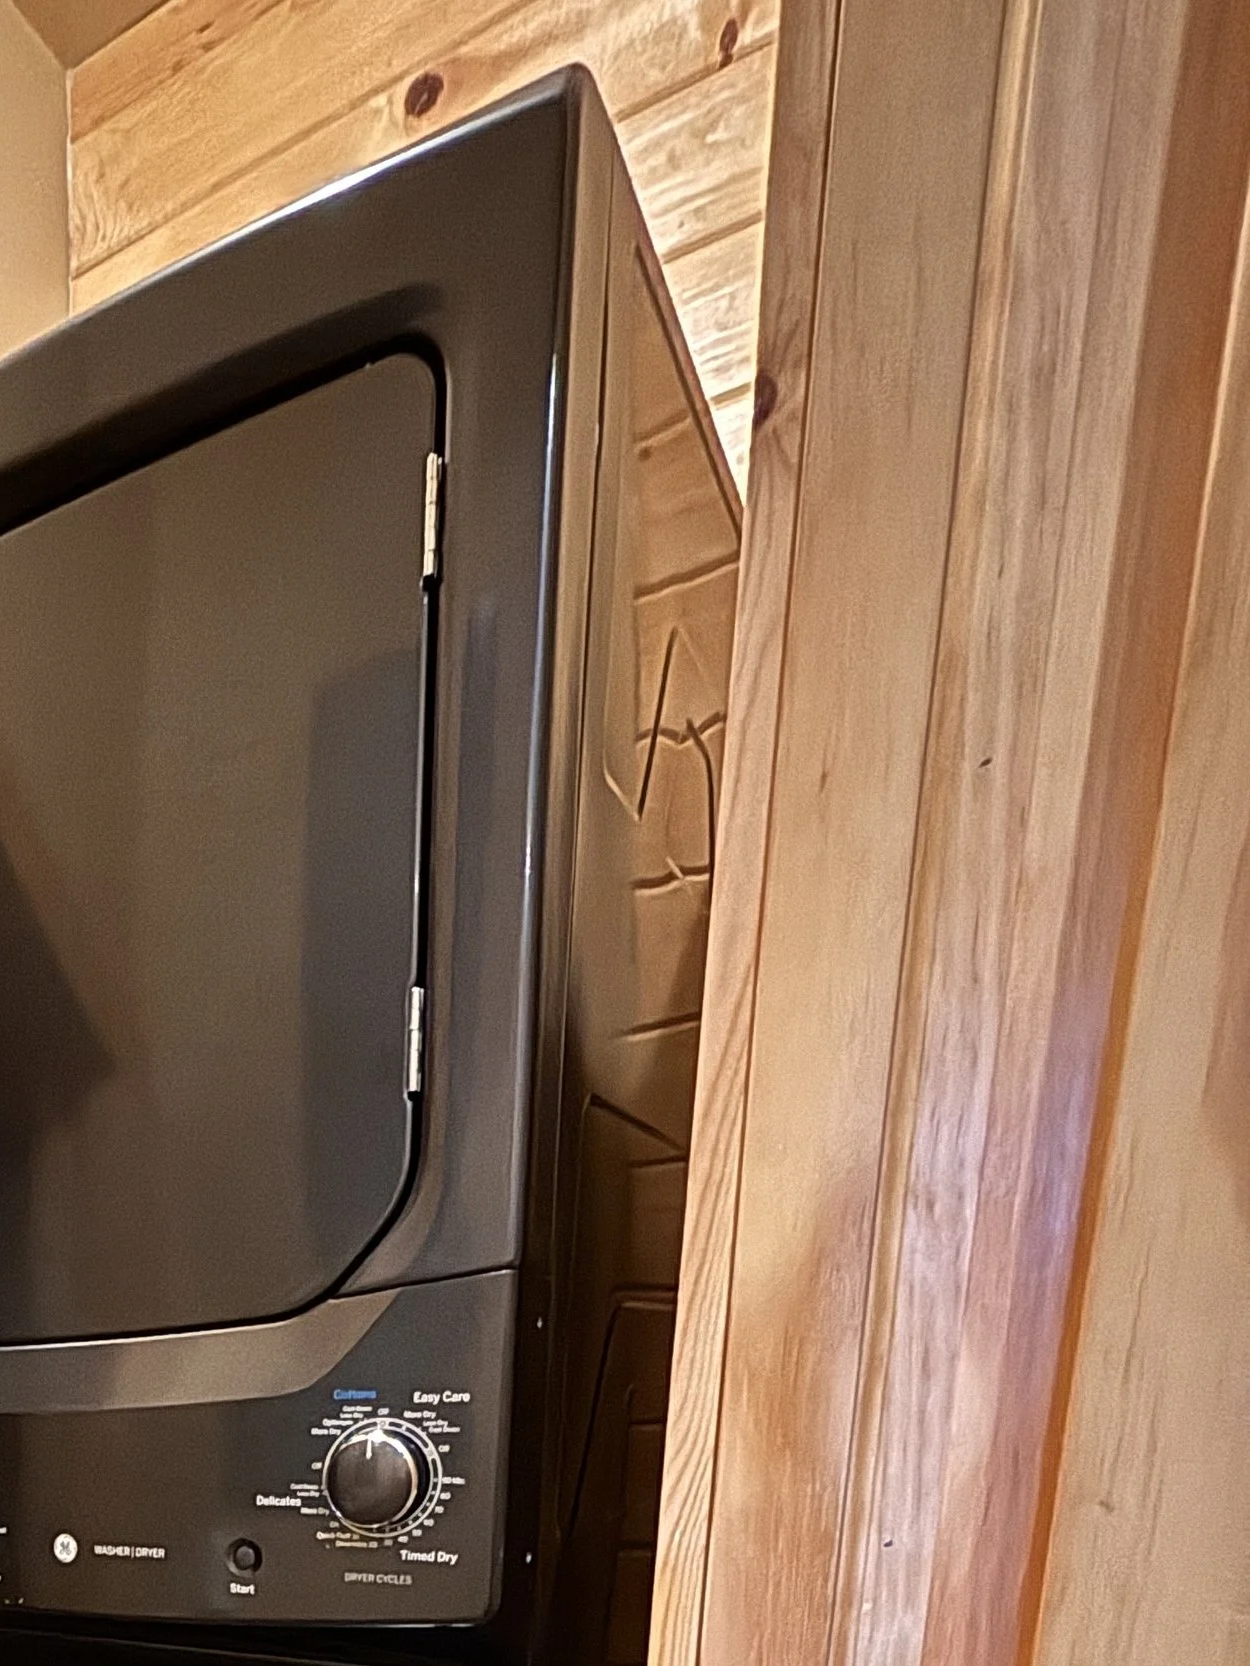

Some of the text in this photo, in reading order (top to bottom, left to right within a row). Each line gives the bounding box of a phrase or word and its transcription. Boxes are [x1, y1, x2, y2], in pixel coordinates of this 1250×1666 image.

[413, 1390, 471, 1405] Easy Care
[255, 1494, 302, 1507] Delicates
[93, 1544, 131, 1557] WASHER
[135, 1546, 166, 1559] DRYER
[399, 1549, 459, 1565] Timed Dry
[343, 1571, 413, 1585] DRYER CYCLES
[229, 1582, 256, 1596] Start
